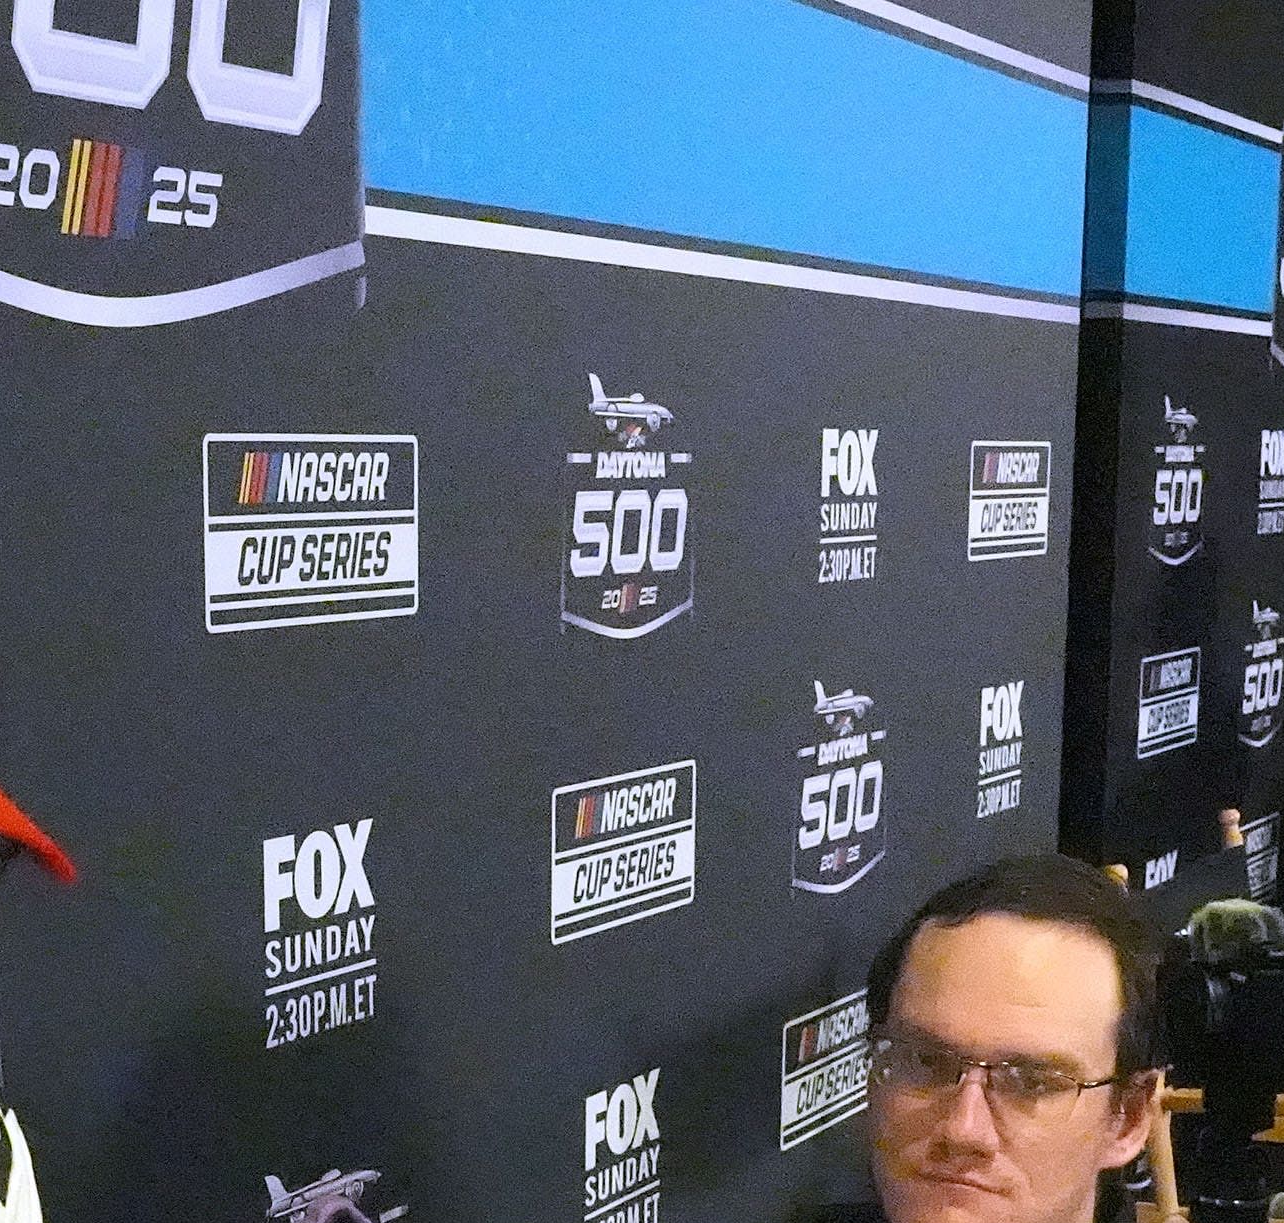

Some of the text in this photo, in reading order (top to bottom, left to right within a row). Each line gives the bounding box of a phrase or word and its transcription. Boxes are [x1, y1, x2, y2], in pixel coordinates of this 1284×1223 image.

[147, 166, 224, 229] 25
[277, 452, 391, 503] NASCAR
[595, 451, 667, 479] DAYTONA
[820, 428, 880, 498] FOX
[996, 452, 1040, 484] NASCAR
[820, 501, 878, 532] SUNDAY
[1152, 468, 1203, 526] 500
[237, 531, 392, 587] CUP SERIES
[569, 488, 689, 578] 500
[979, 680, 1025, 747] FOX
[1242, 658, 1284, 715] 500
[978, 741, 1022, 775] SUNDAY
[598, 776, 677, 834] NASCAR
[798, 759, 884, 850] 500
[263, 818, 376, 934] FOX
[572, 839, 677, 905] CUP SERIES
[265, 914, 376, 980] SUNDAY
[584, 1067, 661, 1171] FOX
[584, 1144, 661, 1208] SUNDAY
